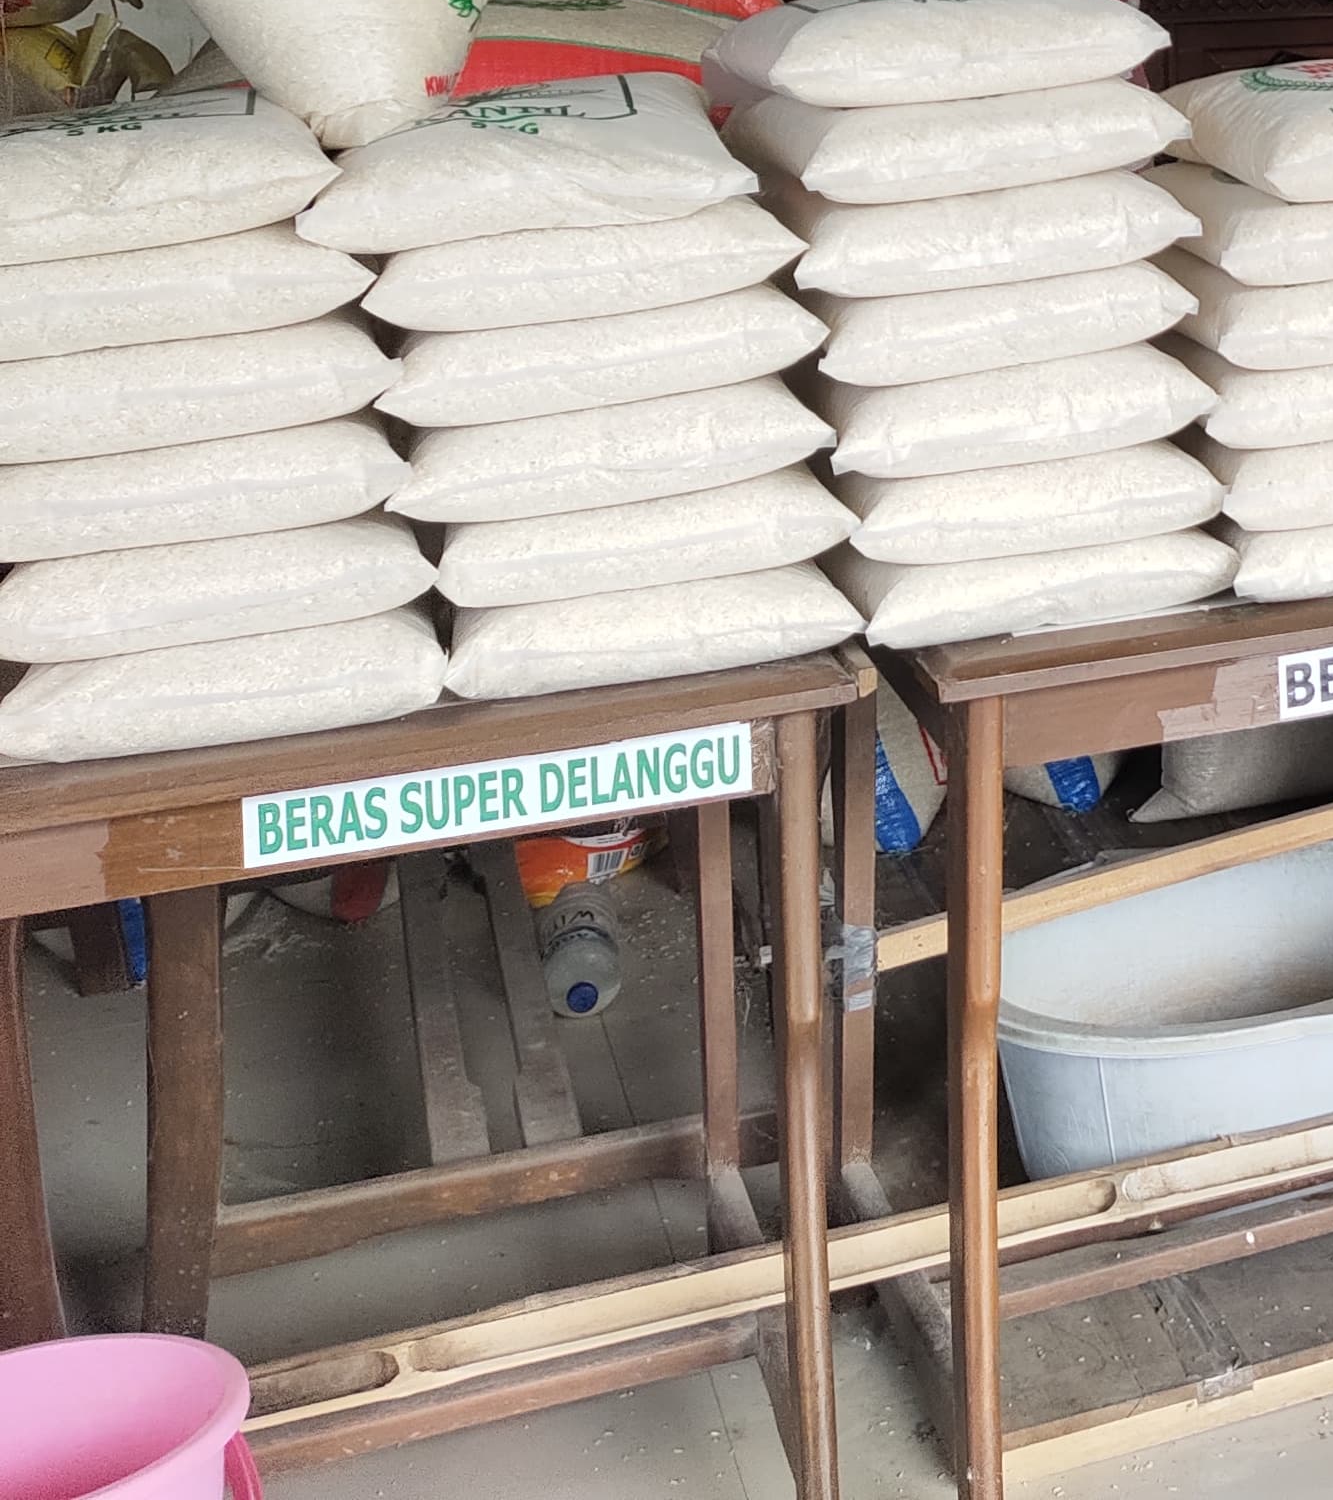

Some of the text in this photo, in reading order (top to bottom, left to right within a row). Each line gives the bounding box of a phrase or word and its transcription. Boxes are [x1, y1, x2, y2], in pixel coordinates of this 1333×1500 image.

[97, 122, 143, 134] KG
[257, 735, 743, 856] BERAS SUPER DELANGGU
